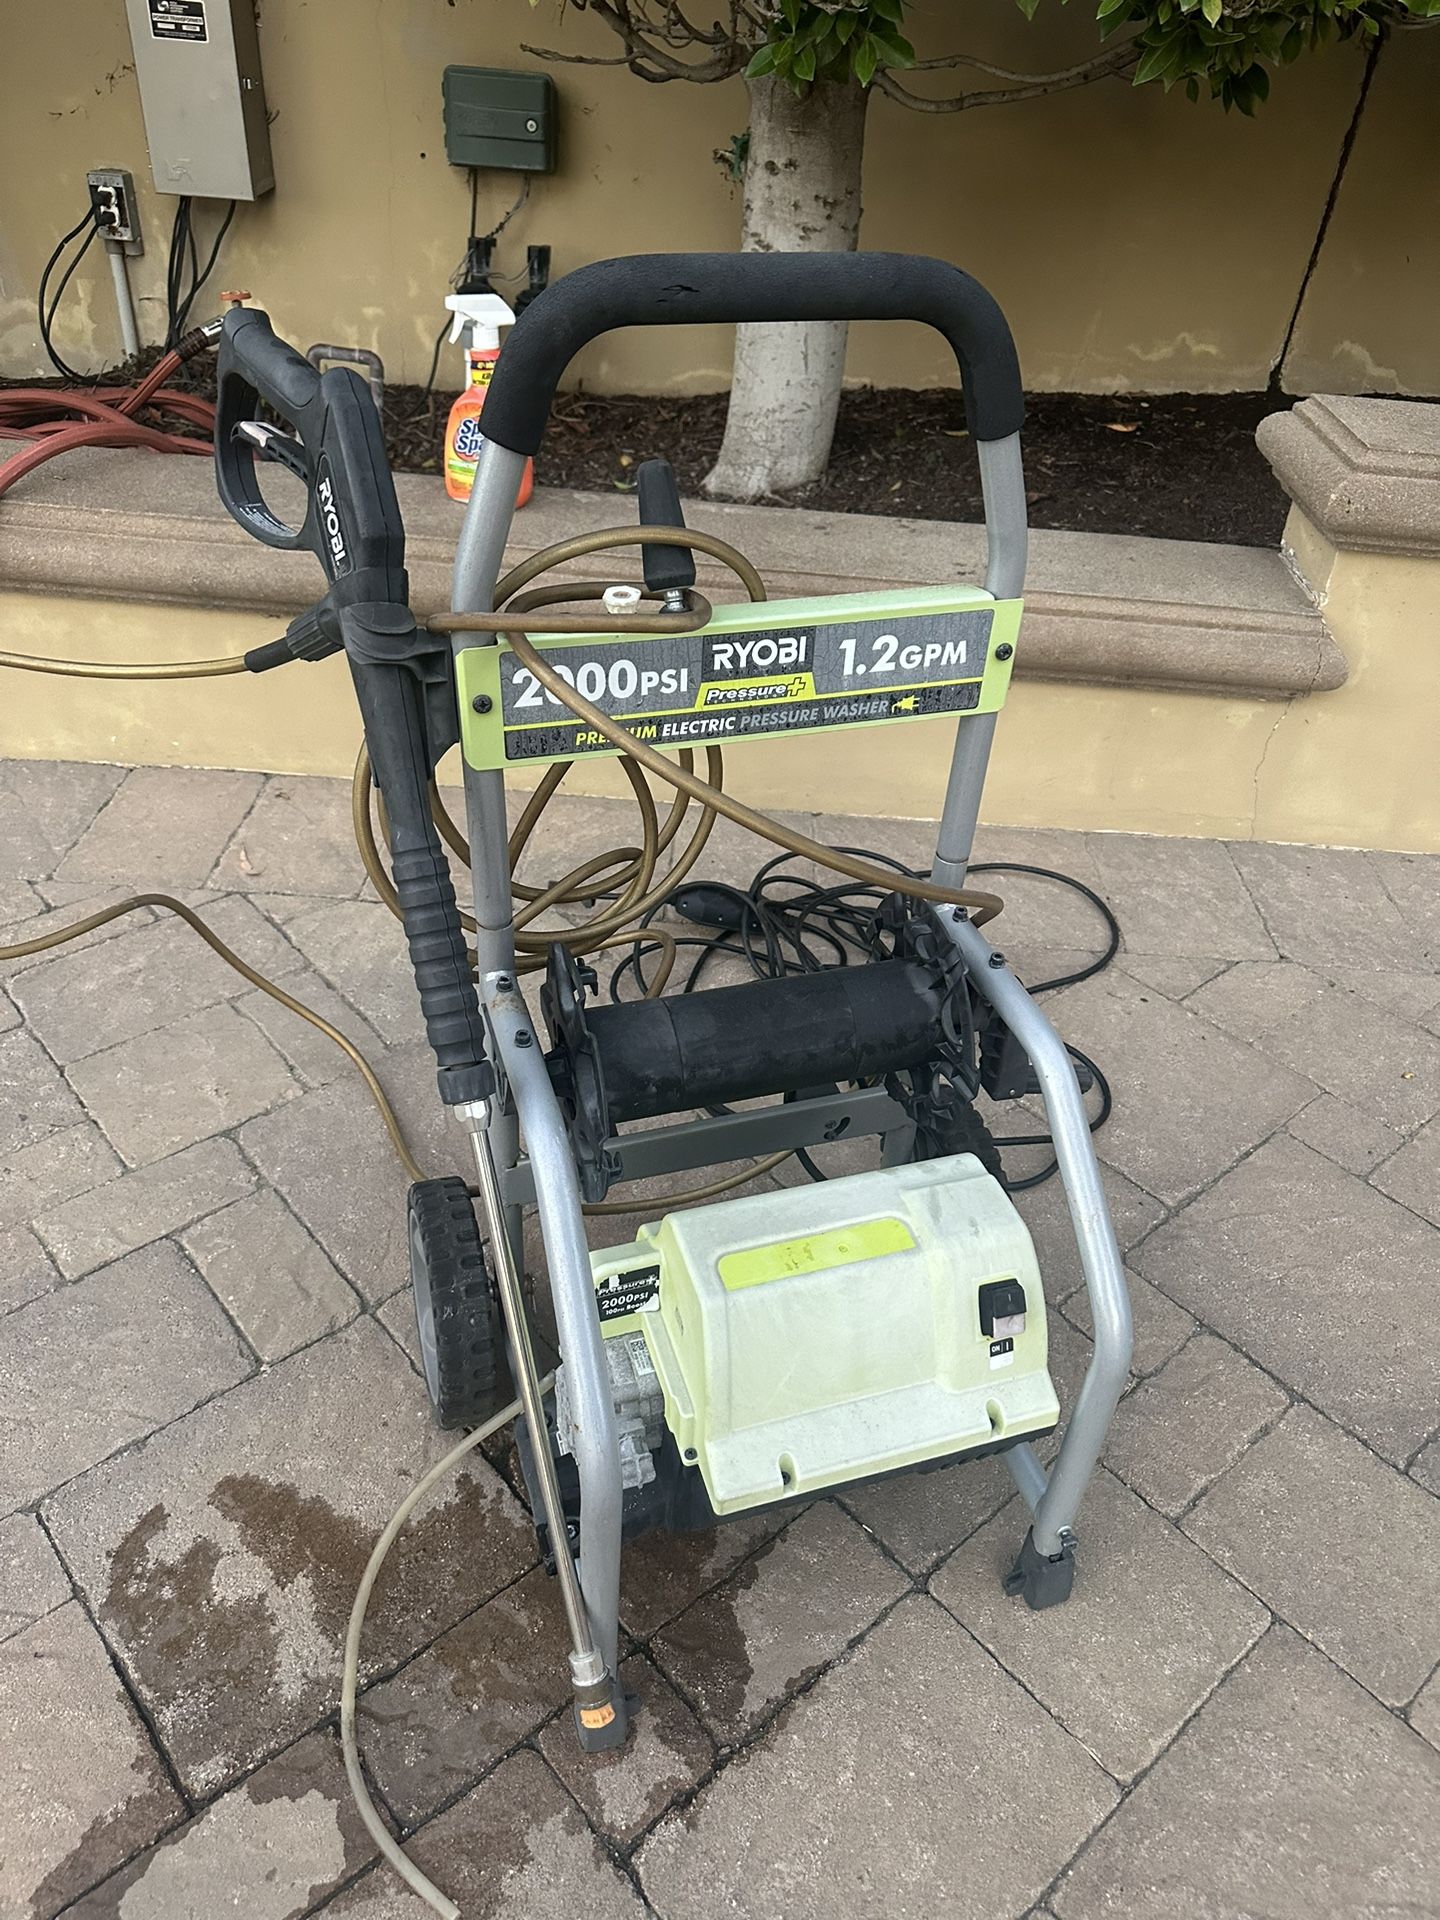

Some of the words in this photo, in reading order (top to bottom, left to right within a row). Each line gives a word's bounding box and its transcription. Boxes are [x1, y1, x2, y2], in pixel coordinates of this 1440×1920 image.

[319, 476, 346, 561] RYOBI
[712, 636, 807, 670] RYOBI
[838, 634, 967, 676] 1.2GPM
[576, 725, 657, 746] PREUM
[662, 716, 736, 737] ELECTRIC
[740, 708, 819, 728] PRESSURE
[823, 701, 889, 719] WASHER
[601, 1291, 649, 1309] 2000PSI
[992, 1345, 1001, 1353] ON
